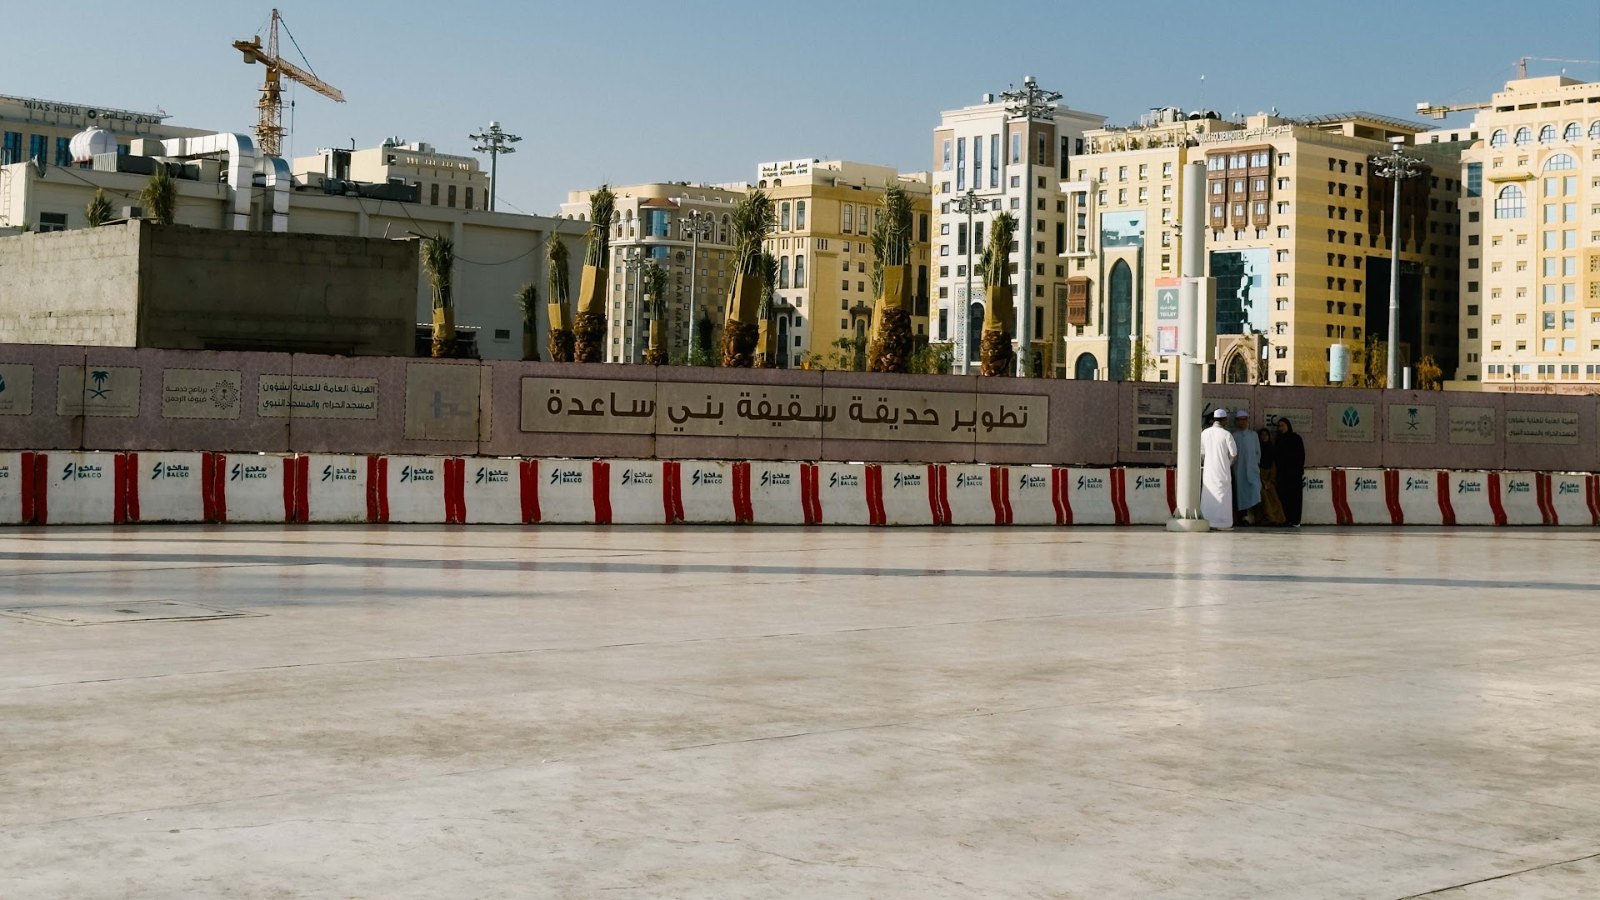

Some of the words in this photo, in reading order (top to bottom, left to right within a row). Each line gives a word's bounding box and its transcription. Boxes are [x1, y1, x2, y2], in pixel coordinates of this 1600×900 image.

[24, 101, 50, 112] MIAS
[54, 105, 81, 116] HOTEL
[135, 114, 159, 124] فندق
[188, 385, 208, 394] برنامج
[263, 381, 291, 392] بشؤون
[293, 382, 320, 392] للعناية
[324, 382, 348, 393] العامة
[352, 383, 375, 393] الهيئة
[165, 395, 186, 403] الرحمن
[263, 399, 285, 410] النبوي
[286, 399, 320, 409] والمسجد
[323, 400, 346, 409] الحرام
[547, 388, 655, 417] ساعدة
[346, 401, 375, 411] المسجد
[737, 392, 836, 427] سقيفة
[668, 395, 724, 432] بني
[848, 395, 939, 430] حديقة
[952, 405, 1028, 432] تطوير
